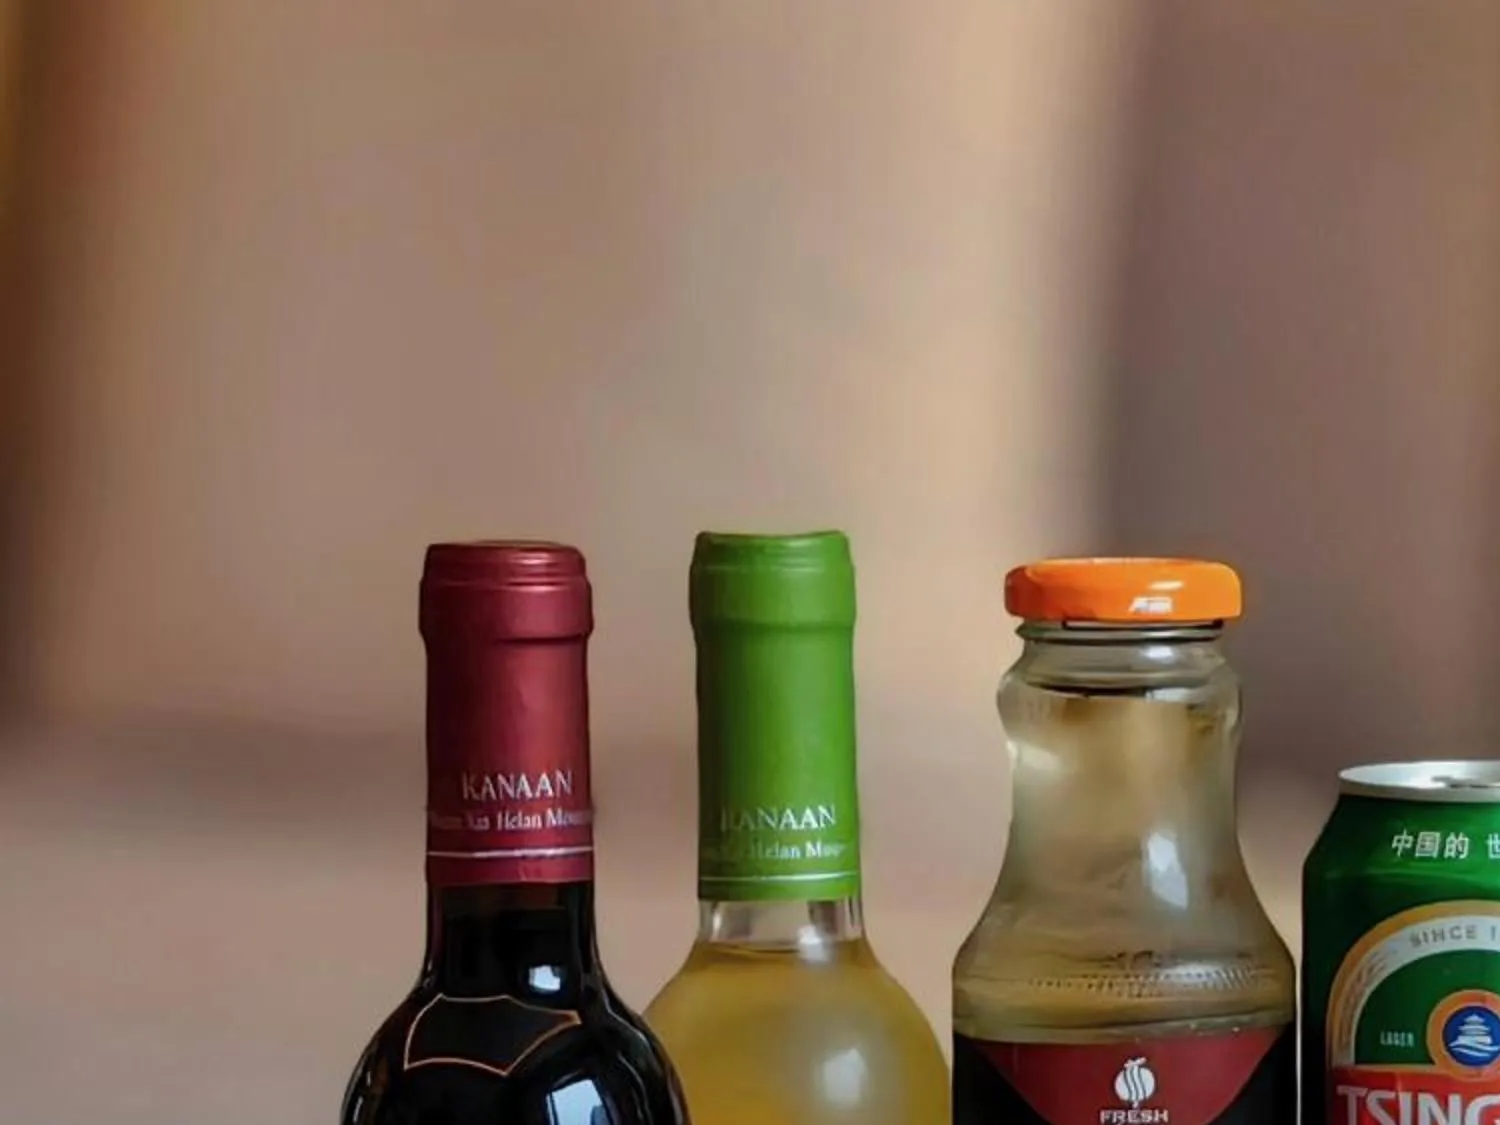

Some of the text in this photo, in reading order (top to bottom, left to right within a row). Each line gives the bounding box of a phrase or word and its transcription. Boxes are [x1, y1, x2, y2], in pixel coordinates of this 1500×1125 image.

[462, 769, 572, 801] KANAAN
[1392, 828, 1470, 860] 中国的
[1409, 925, 1478, 948] SINCE
[1100, 1109, 1169, 1125] FRESH
